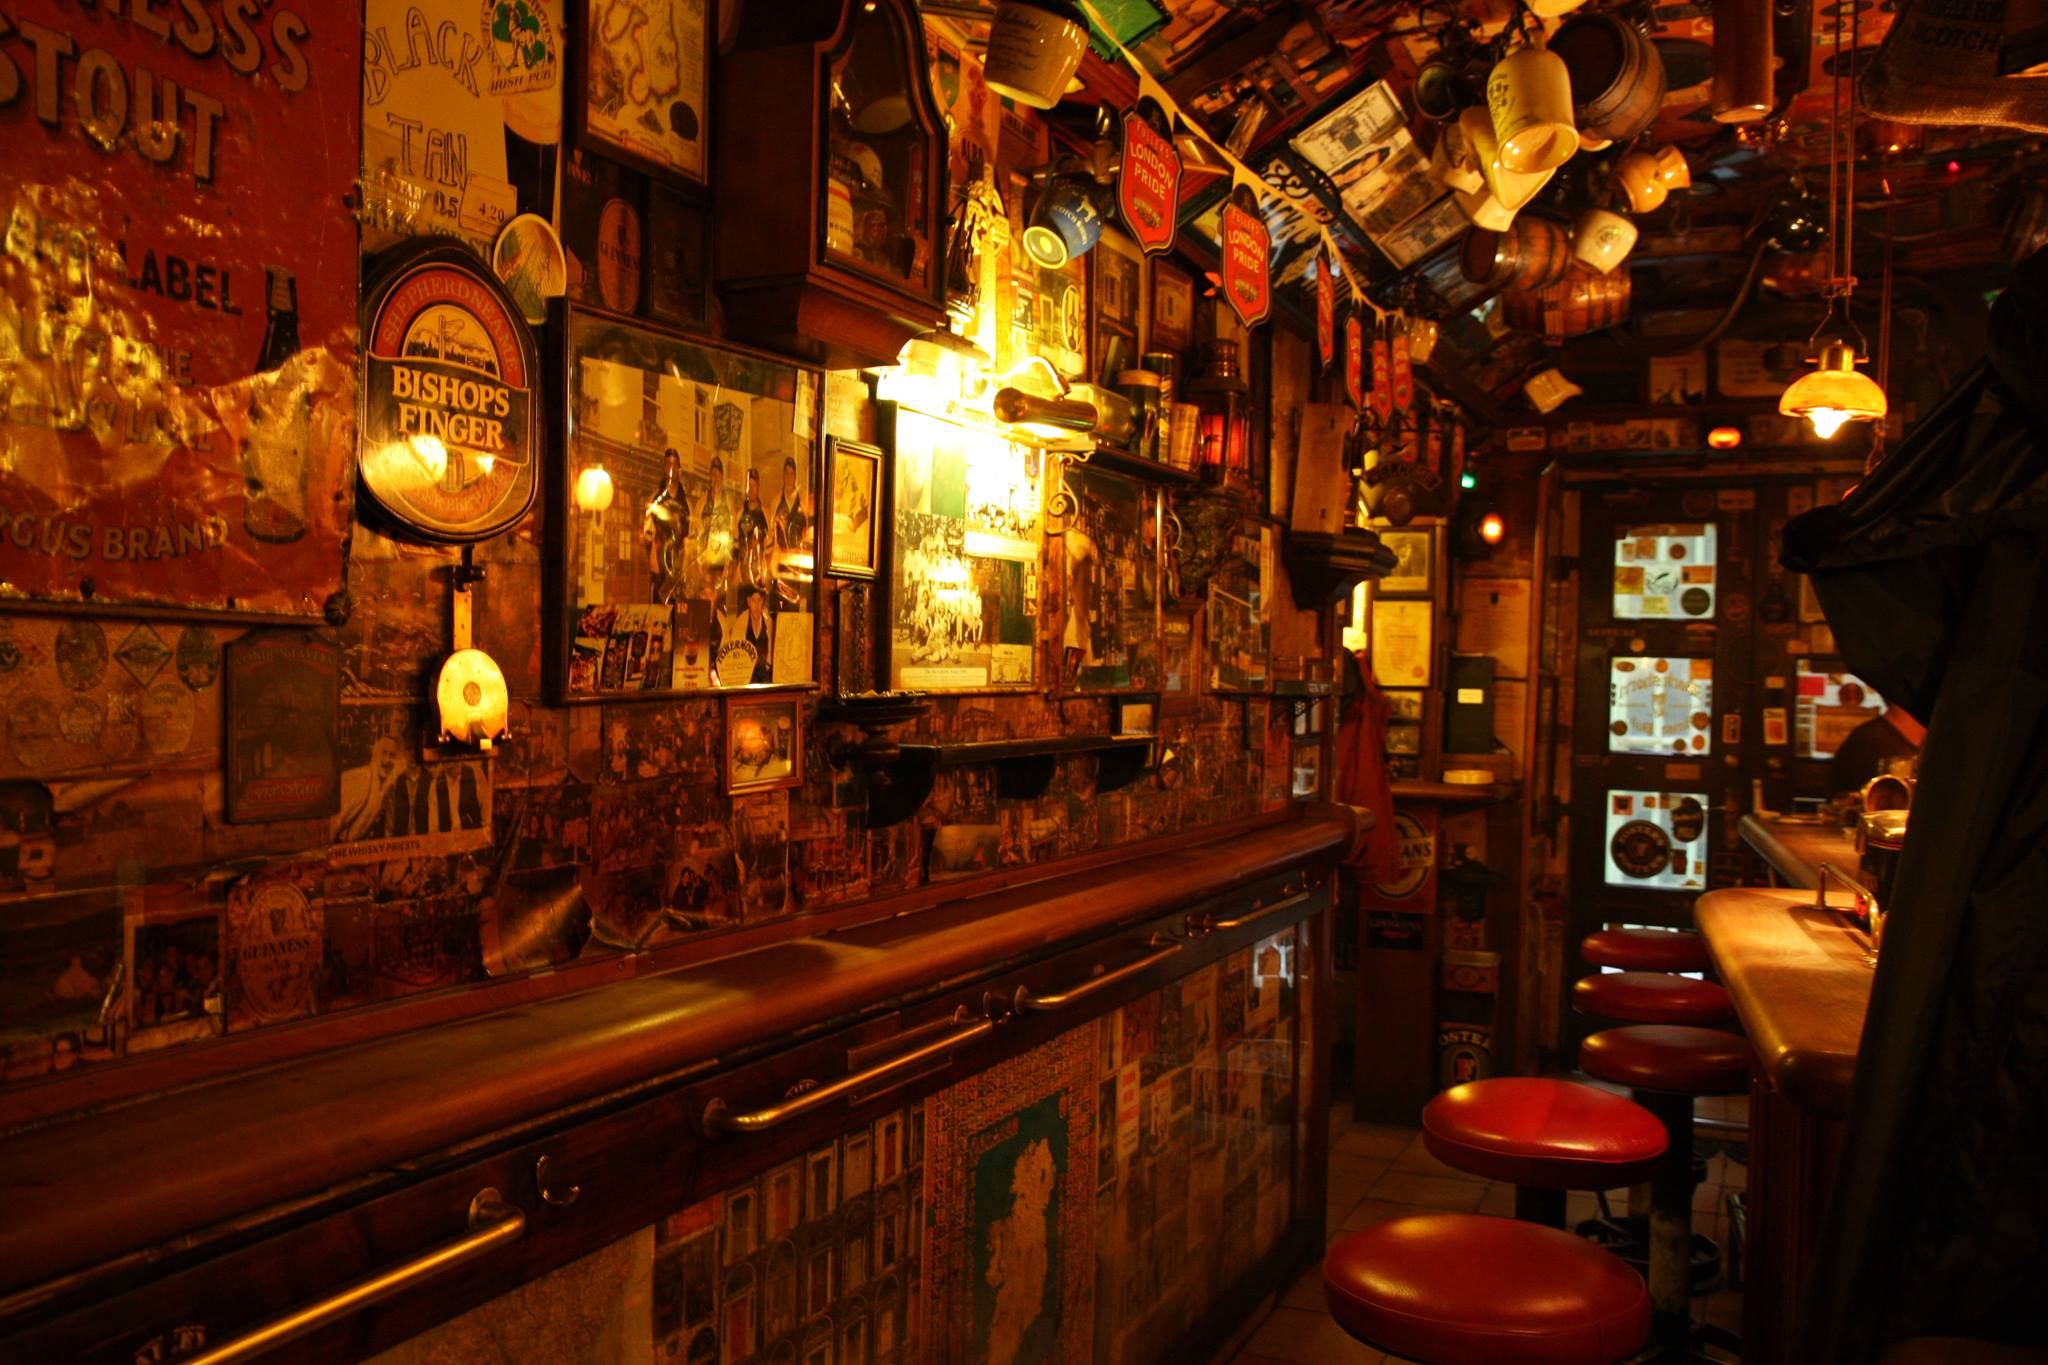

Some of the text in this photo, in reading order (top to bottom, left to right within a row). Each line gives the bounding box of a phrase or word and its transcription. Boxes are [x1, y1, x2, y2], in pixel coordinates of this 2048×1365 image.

[387, 112, 468, 191] TAN
[1130, 142, 1174, 189] LONDON
[1134, 162, 1167, 200] PRIDE
[1228, 230, 1265, 262] LONDON
[1232, 248, 1262, 274] PRIDE
[118, 238, 244, 316] LABEL
[383, 275, 519, 373] SHEPHERD NEAME
[391, 364, 510, 417] BISHOPS
[398, 401, 505, 450] FINGER
[103, 514, 230, 561] BRAND
[716, 640, 758, 664] TOBERMORY
[350, 843, 384, 858] WHISKY
[386, 839, 421, 852] PRIESTS
